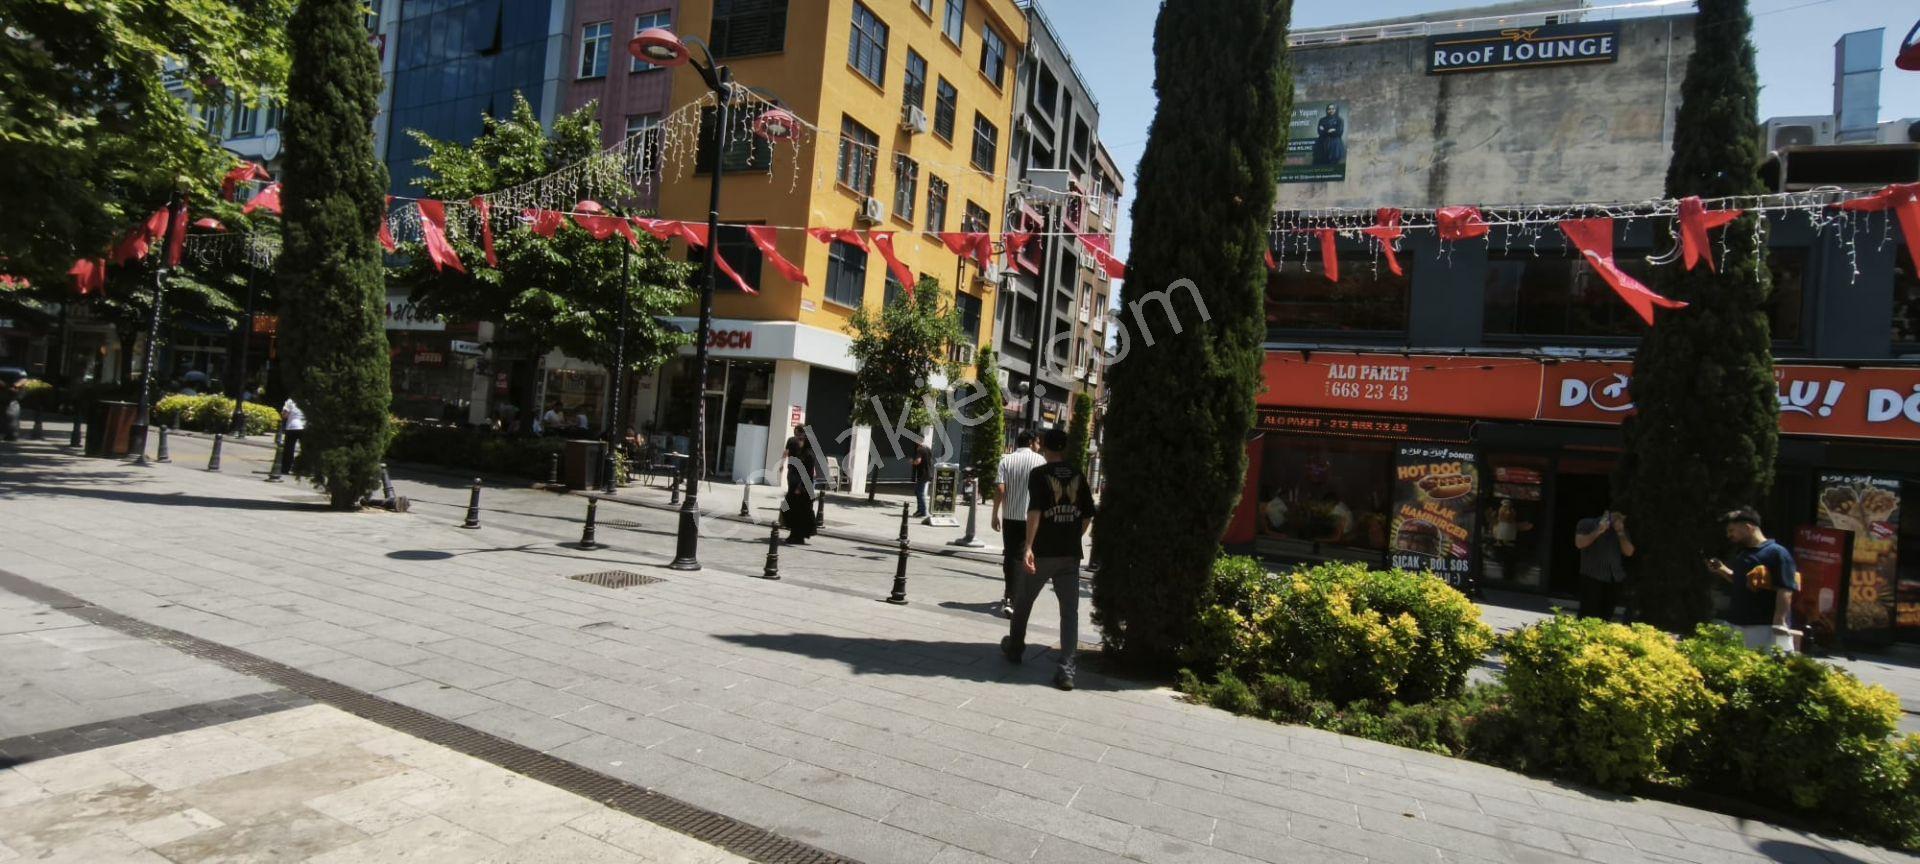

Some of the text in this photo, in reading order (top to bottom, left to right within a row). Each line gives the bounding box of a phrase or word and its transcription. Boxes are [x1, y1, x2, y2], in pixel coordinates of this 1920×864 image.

[1503, 37, 1613, 61] LOUNGE
[707, 329, 752, 348] OSCH
[1328, 364, 1410, 381] ALO PAKET
[1331, 382, 1360, 398] 668
[1365, 383, 1384, 400] 23
[1389, 385, 1409, 401] 43
[1287, 417, 1321, 428] PAKET
[1397, 462, 1462, 479] HOT DOG
[1401, 504, 1468, 540] HAMBURGER
[1392, 555, 1469, 571] SICAK BOL SOS
